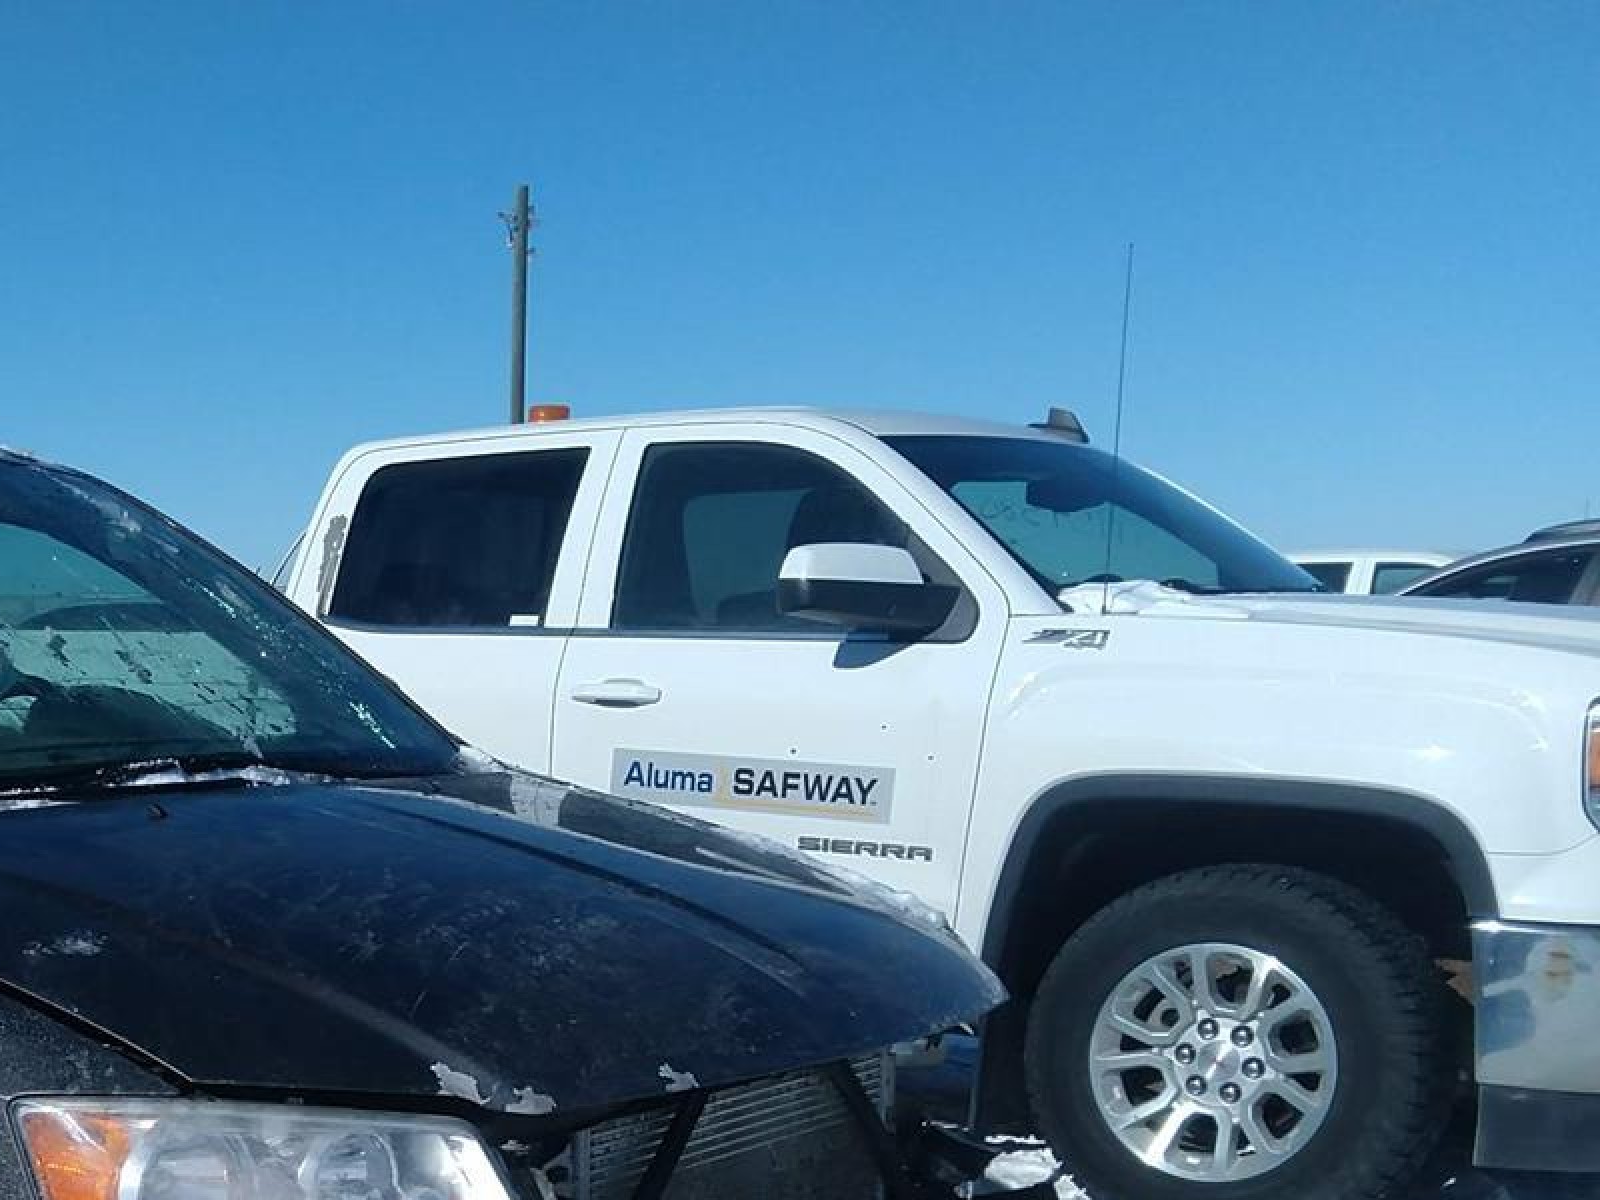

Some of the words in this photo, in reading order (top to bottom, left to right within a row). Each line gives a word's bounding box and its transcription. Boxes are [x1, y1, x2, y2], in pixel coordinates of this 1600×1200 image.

[624, 760, 713, 793] Aluma
[732, 768, 879, 806] SAFWAY
[797, 836, 933, 862] SIERRA
